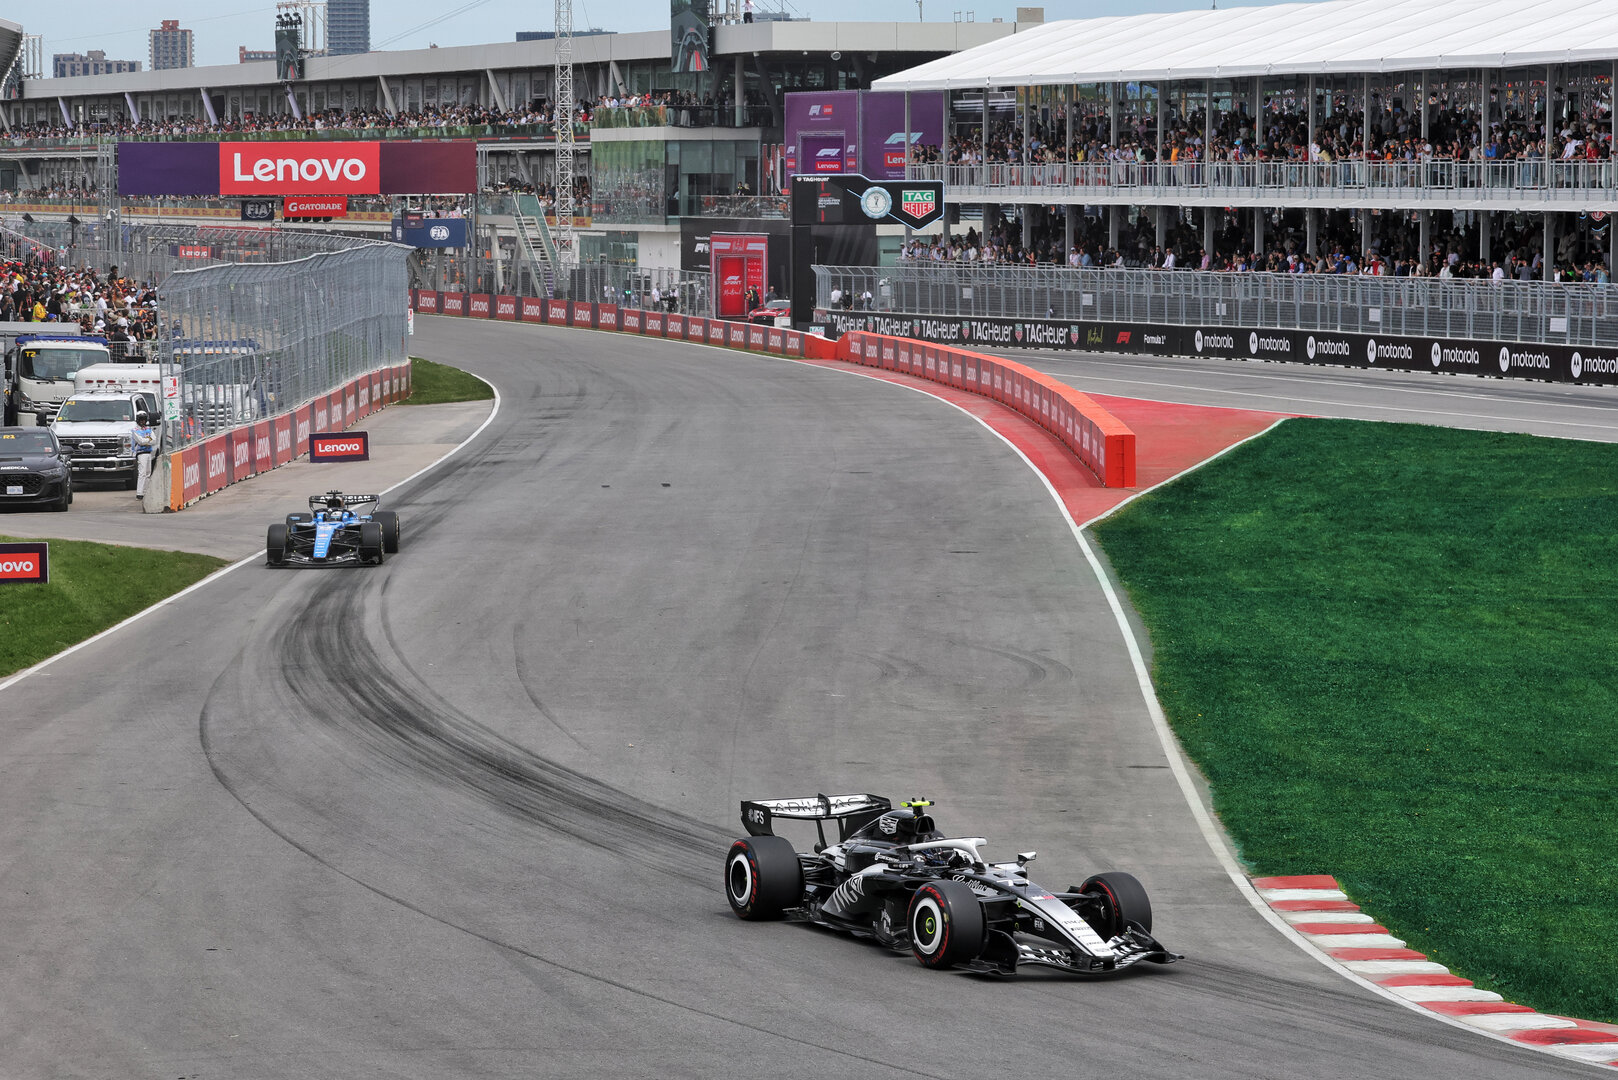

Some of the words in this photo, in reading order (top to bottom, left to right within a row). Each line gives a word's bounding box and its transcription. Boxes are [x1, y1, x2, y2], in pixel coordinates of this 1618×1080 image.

[888, 156, 906, 164] Len
[234, 153, 366, 181] Lenovo
[905, 193, 932, 201] TAG
[246, 204, 269, 216] FIA
[299, 203, 342, 211] GATORADE
[905, 203, 935, 217] HEUER
[430, 227, 449, 239] FIA
[420, 294, 435, 307] Lenovo
[445, 296, 461, 310] Lenovo
[471, 298, 488, 312] Lenovo
[498, 300, 514, 314] Lenovo
[523, 302, 540, 316] Lenovo
[549, 304, 566, 319] Lenovo
[575, 307, 590, 322] Lenovo
[600, 309, 615, 324] Lenovo
[1204, 334, 1233, 349] motorola
[1259, 337, 1290, 352] motorola
[1317, 340, 1350, 356] motorola
[1377, 343, 1412, 360] motorola
[1443, 347, 1479, 364] motorola
[1511, 351, 1550, 369] motorola
[1584, 355, 1618, 373] motorol
[318, 443, 360, 453] Lenovo
[183, 462, 199, 489] Lenovo
[208, 451, 226, 478] Lenovo
[234, 440, 249, 468] Lenovo
[256, 434, 270, 460] Lenovo
[0, 561, 33, 572] ovo
